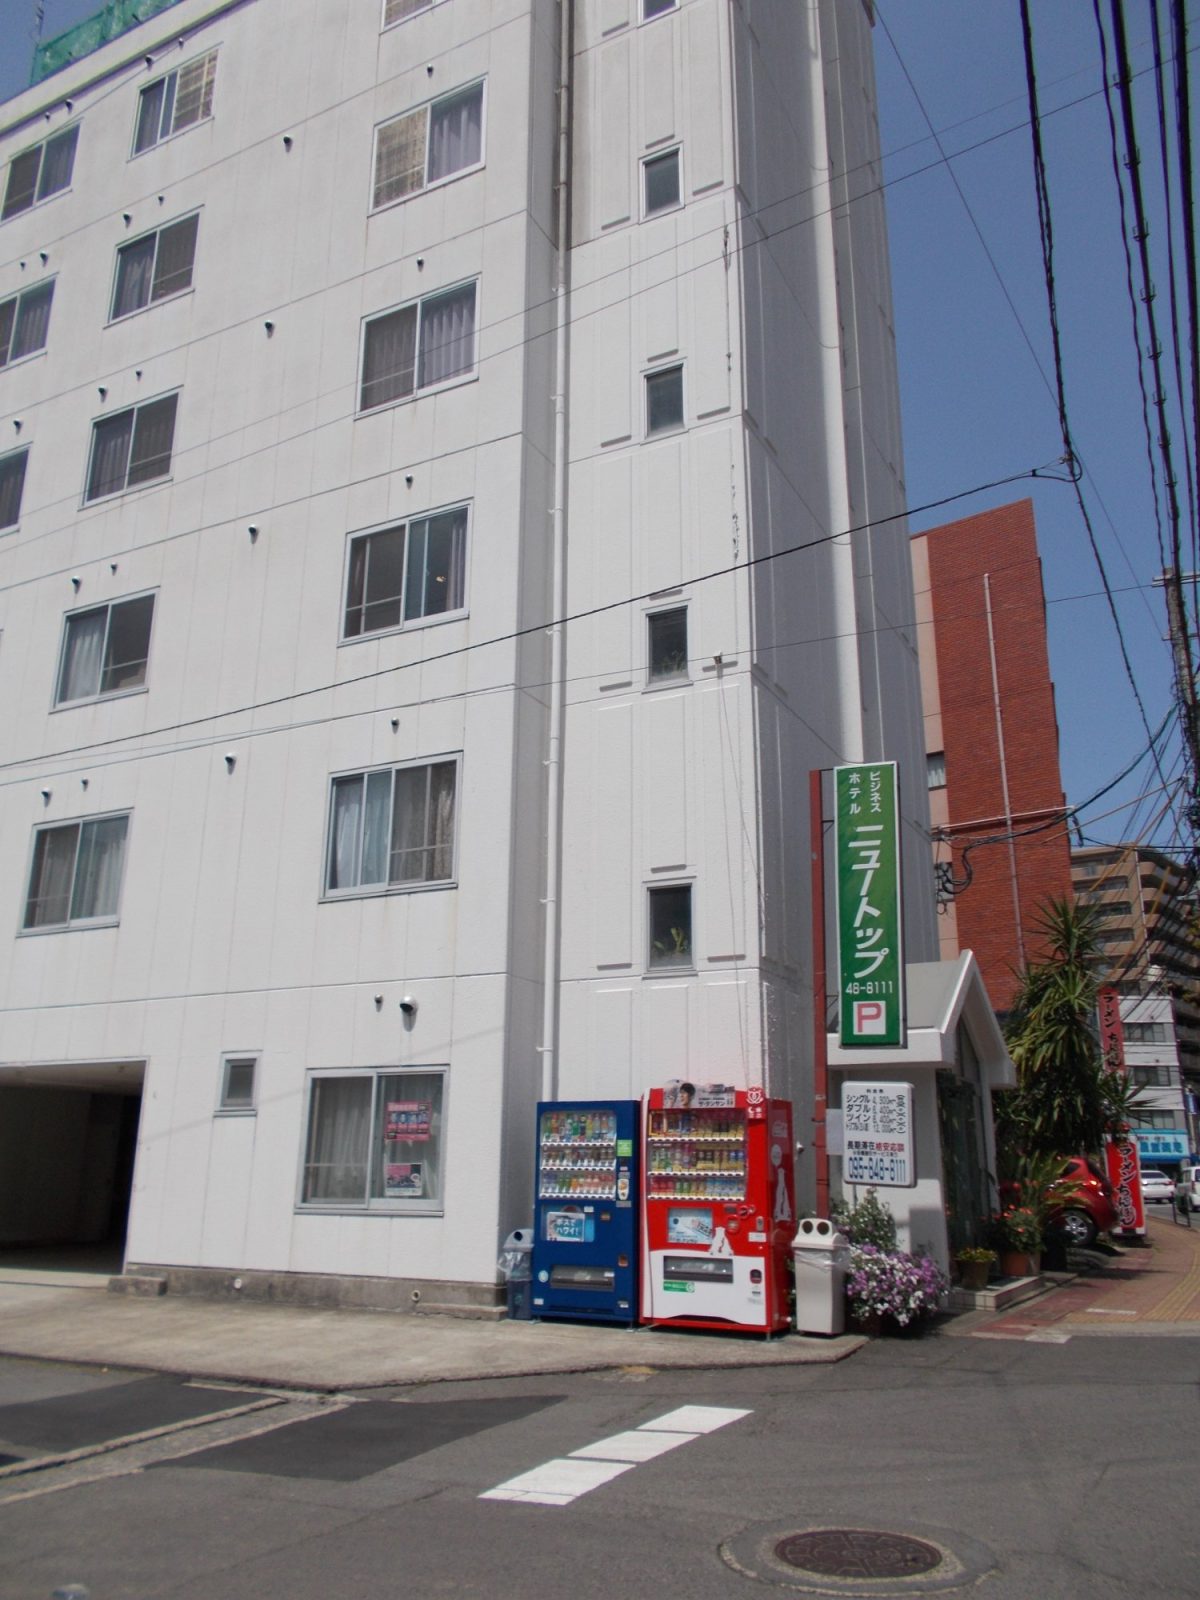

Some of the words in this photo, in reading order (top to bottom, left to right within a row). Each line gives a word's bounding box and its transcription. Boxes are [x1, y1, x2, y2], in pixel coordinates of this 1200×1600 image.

[848, 772, 861, 815] ホテル
[869, 770, 882, 813] ビジネス
[848, 824, 890, 980] ニュートップ
[845, 980, 893, 995] 48-8111
[857, 1002, 882, 1033] P
[1104, 992, 1116, 1028] ラーメン
[846, 1094, 871, 1104] シングル
[846, 1104, 871, 1113] ダブル
[846, 1113, 871, 1122] ツイン
[848, 1156, 906, 1183] 095-848-8111
[1119, 1144, 1136, 1182] ラーメン
